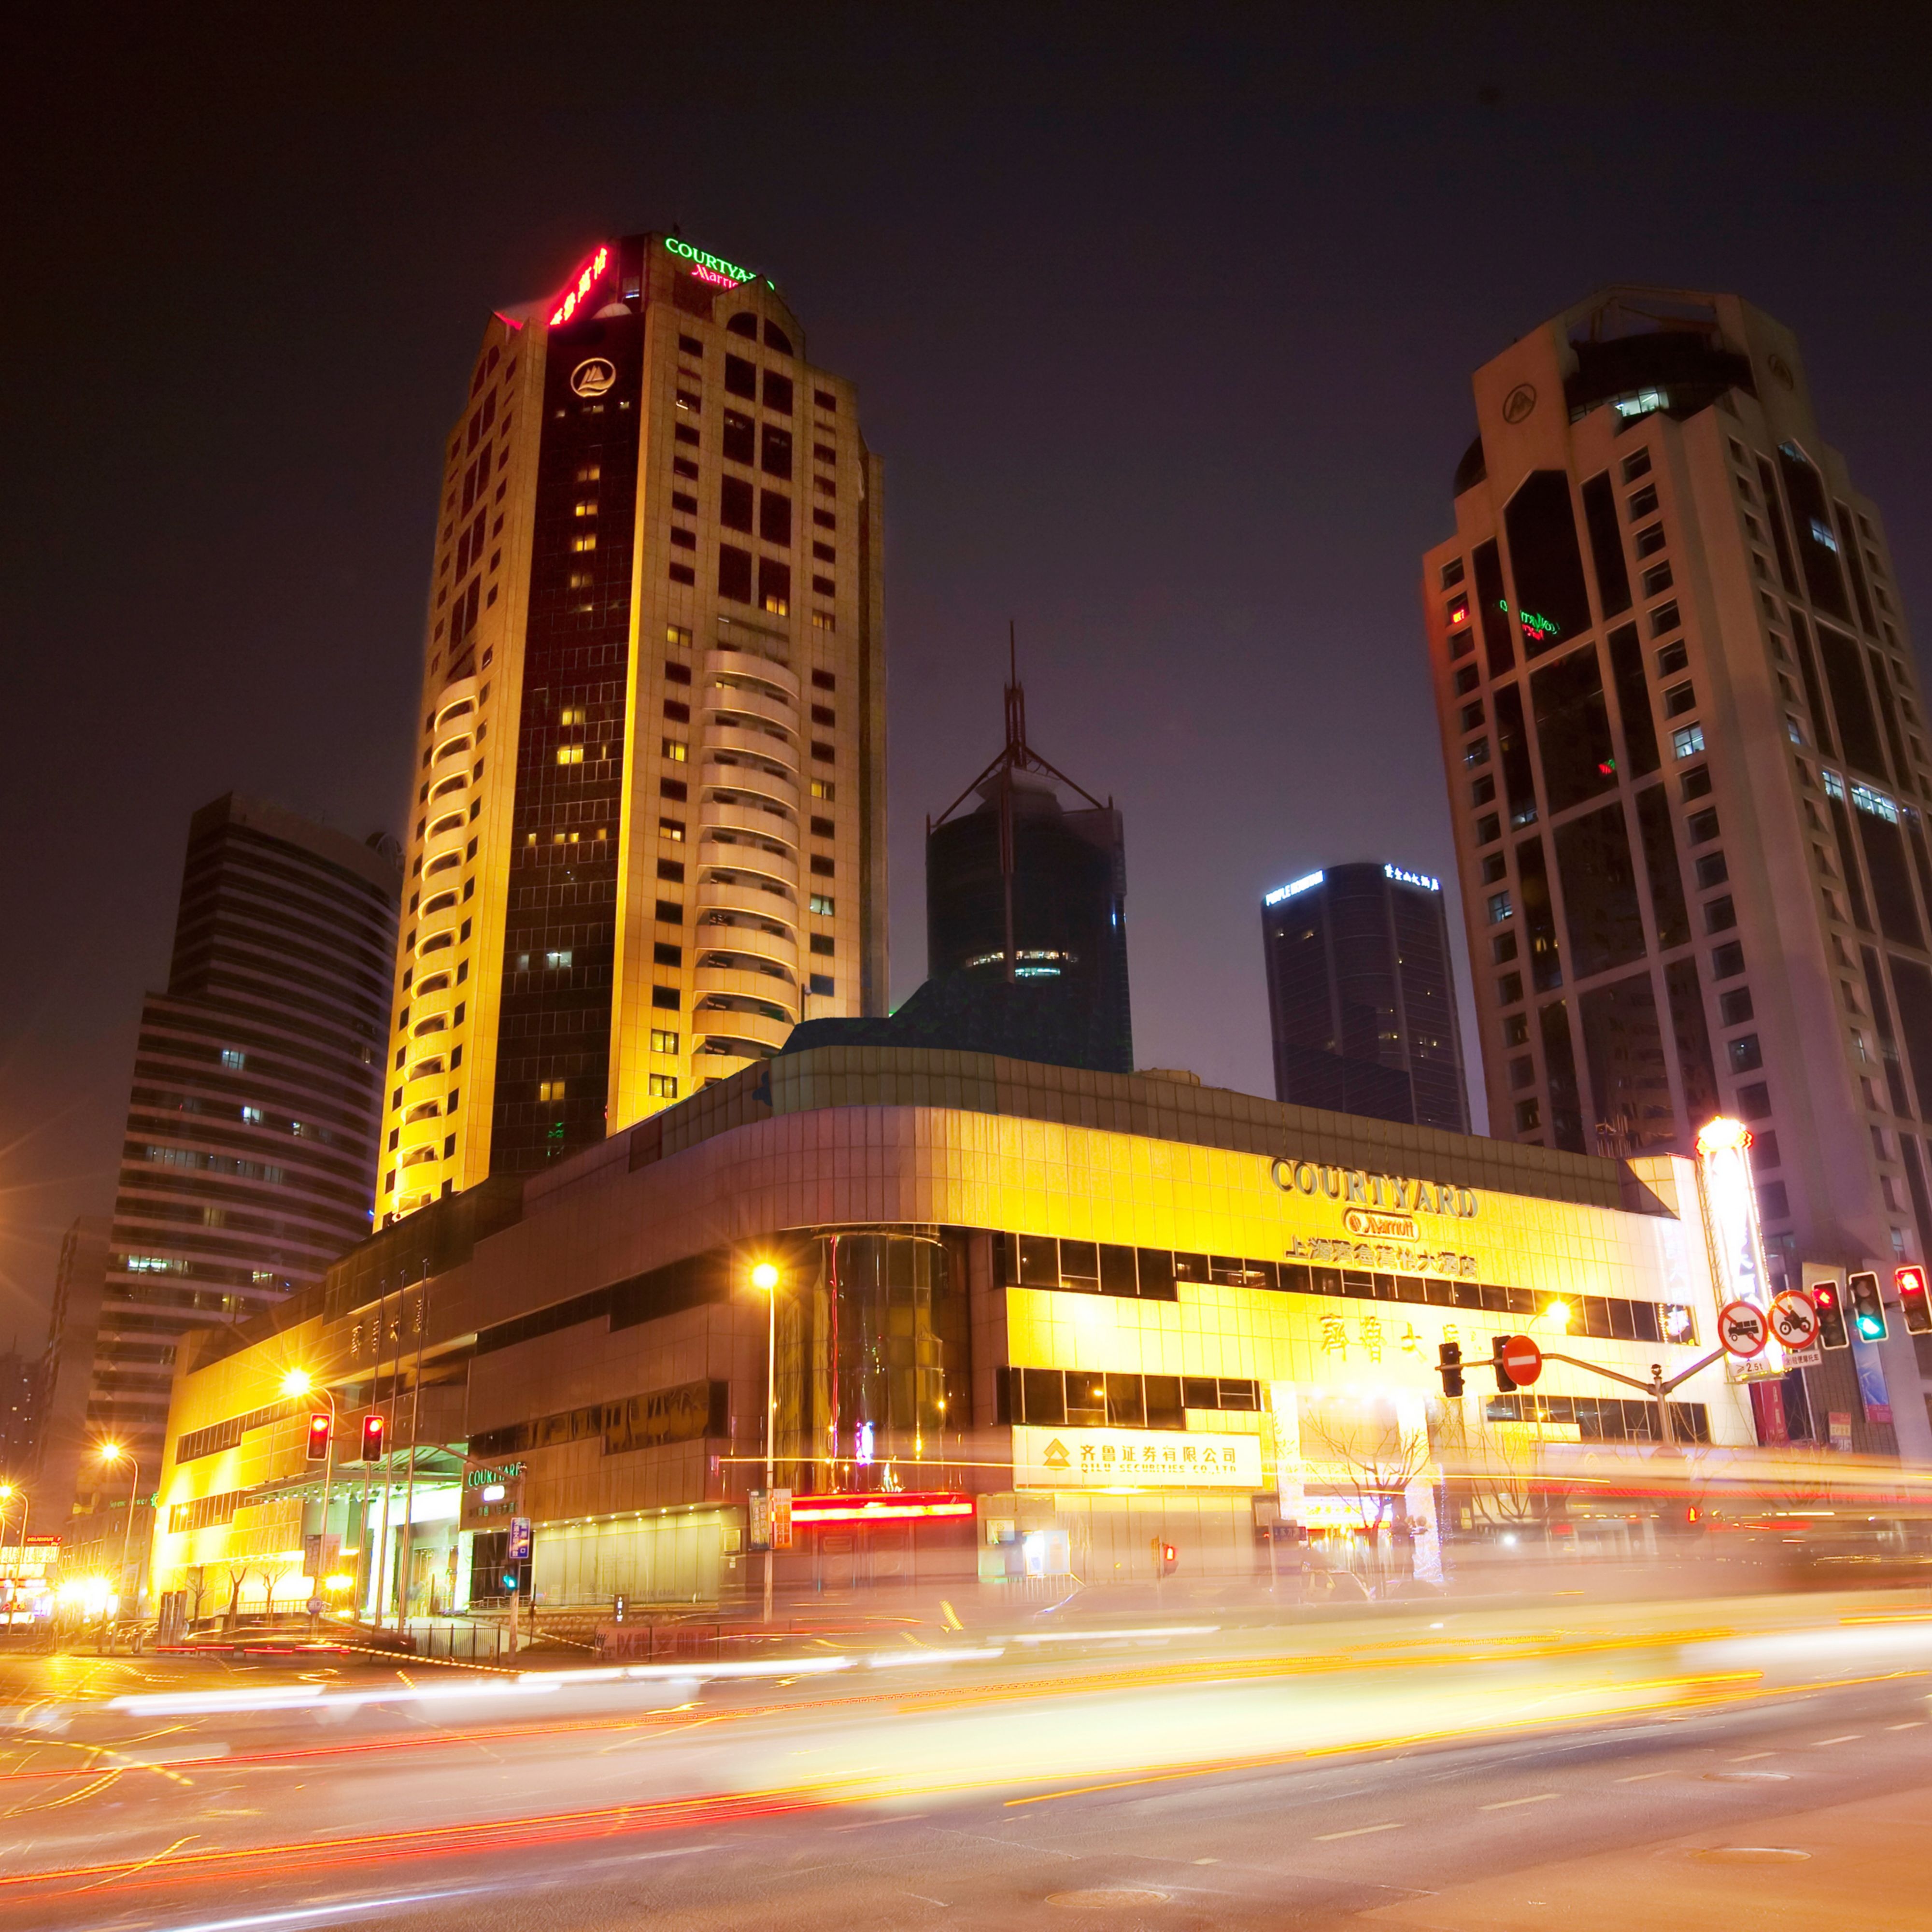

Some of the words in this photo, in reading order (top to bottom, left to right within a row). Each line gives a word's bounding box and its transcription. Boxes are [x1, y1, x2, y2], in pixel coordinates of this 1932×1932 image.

[666, 238, 774, 290] COURTYA
[692, 264, 739, 289] Marri
[1271, 1158, 1478, 1218] COURTYARD
[1364, 1213, 1414, 1237] Marriott
[1080, 1445, 1236, 1463] 齐鲁证券有限公司
[1080, 1463, 1111, 1473] QILU
[1119, 1463, 1185, 1473] SECURITIES
